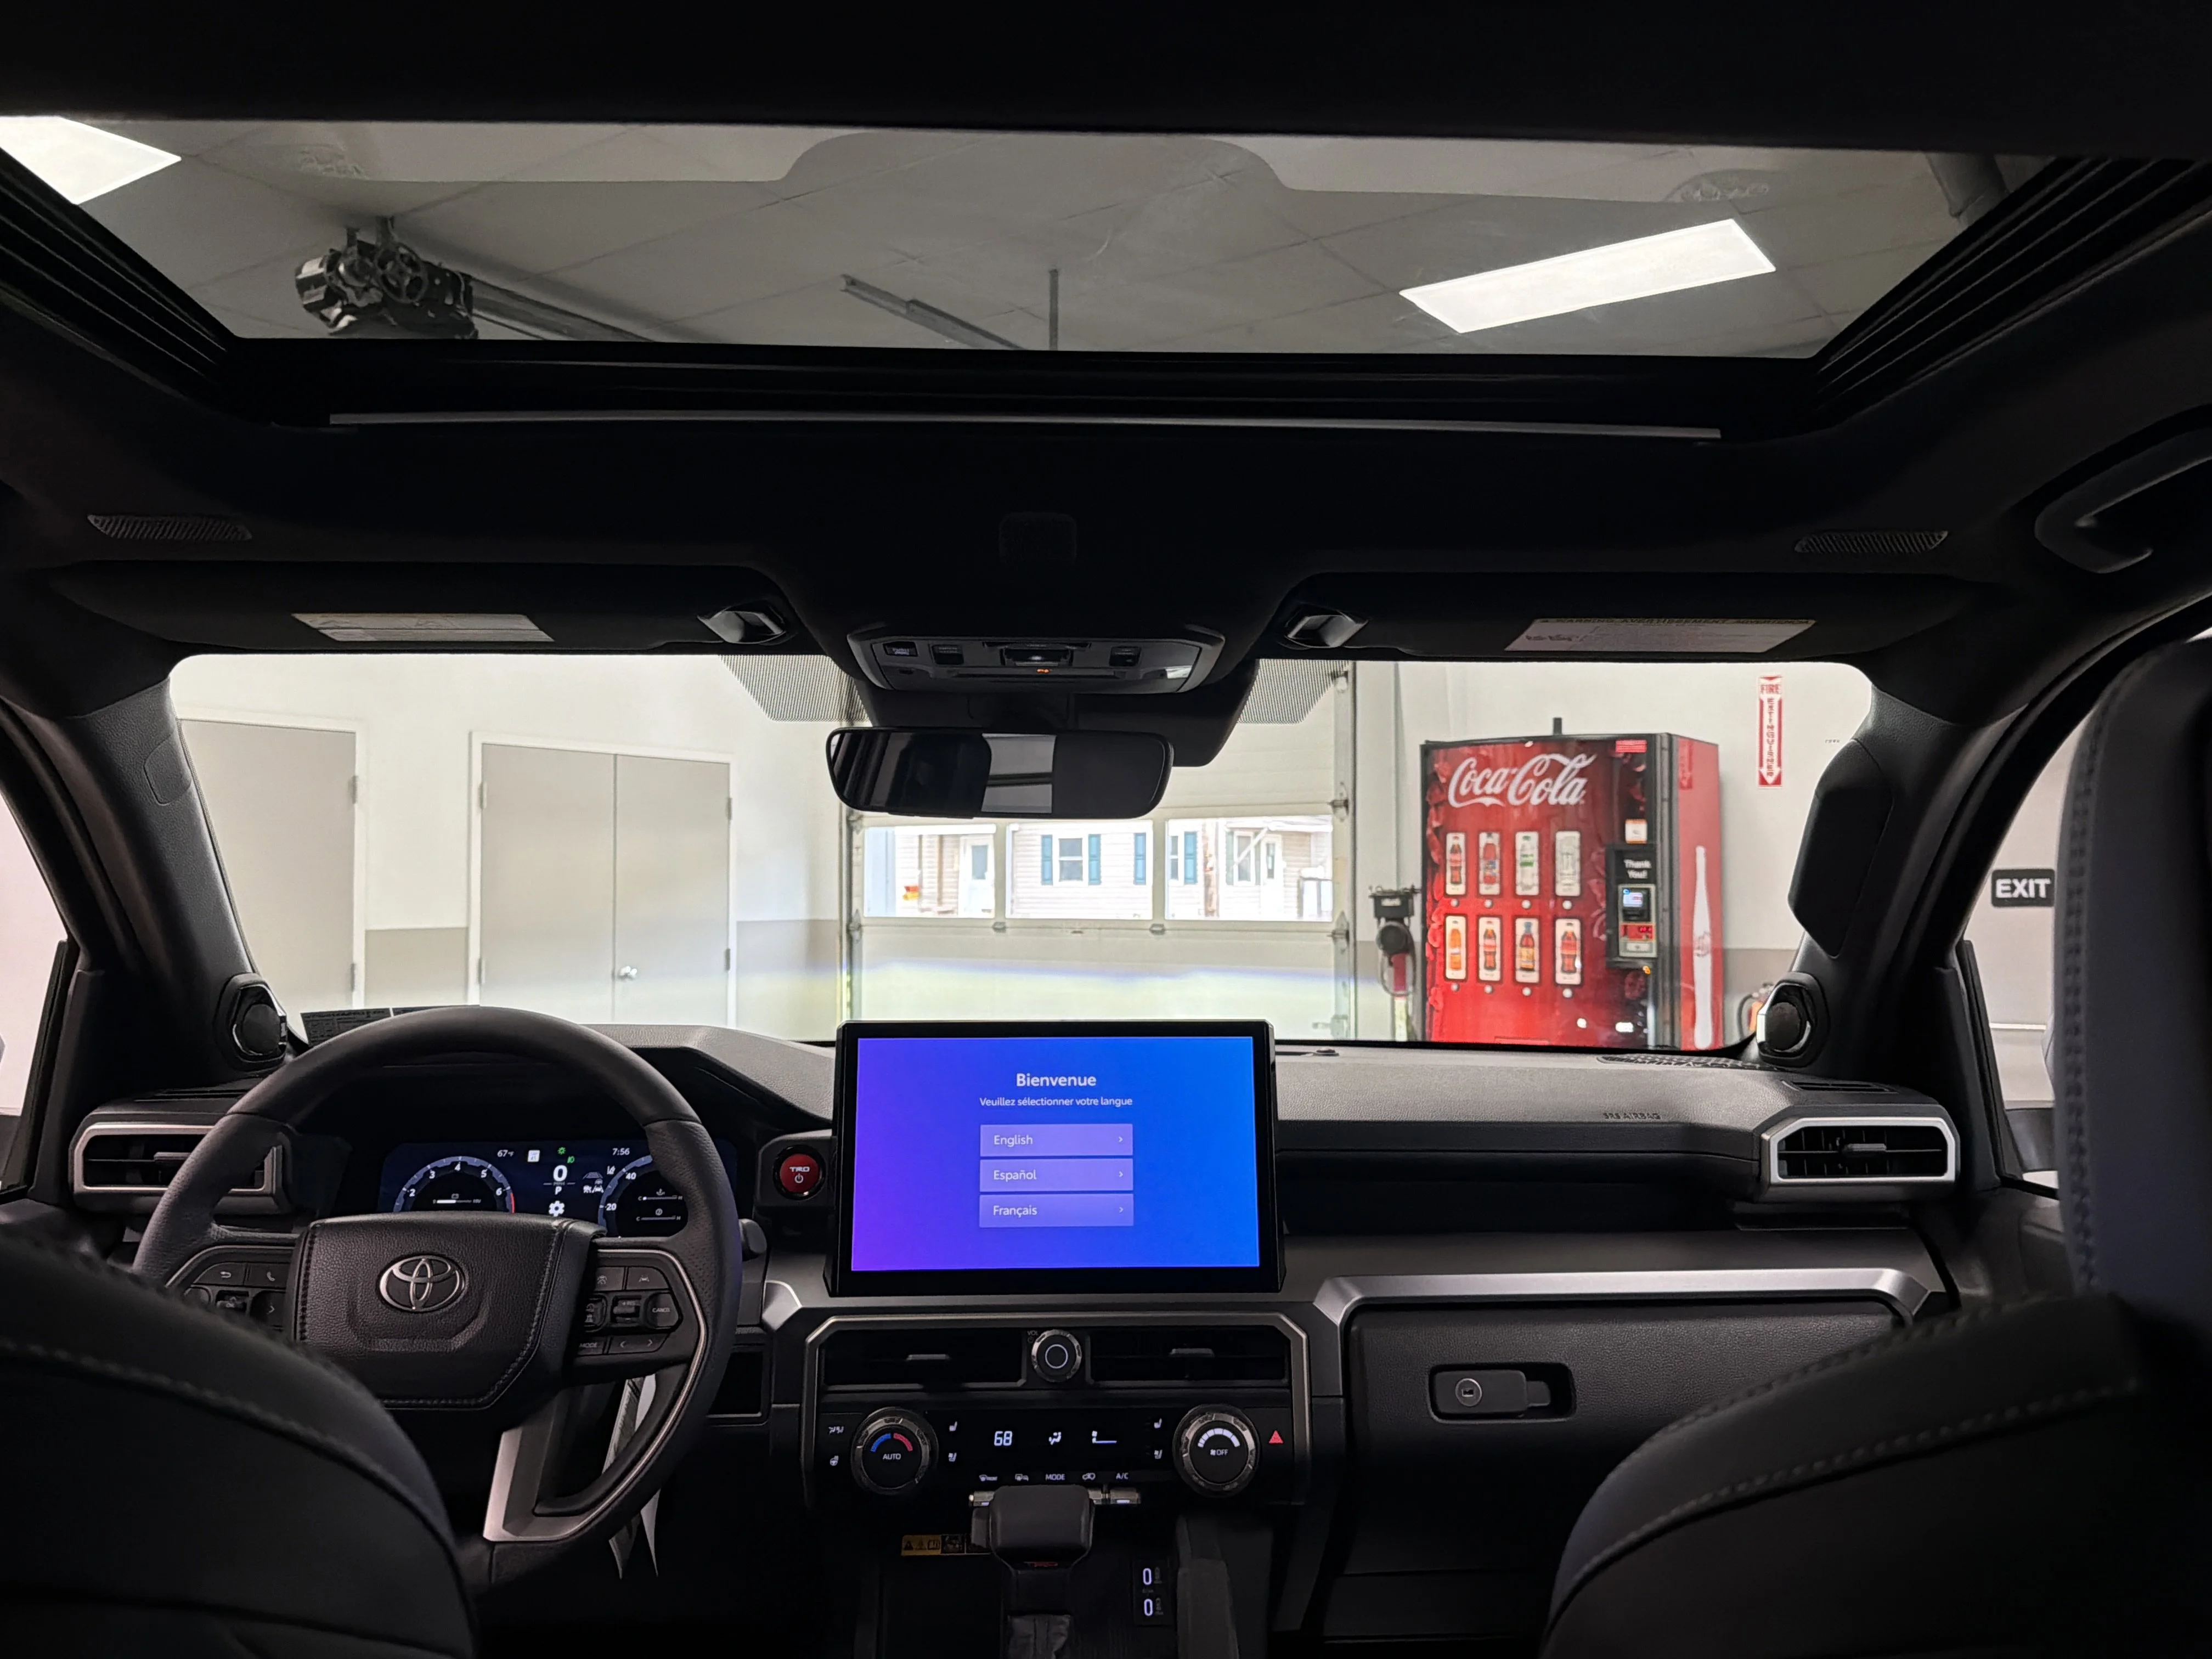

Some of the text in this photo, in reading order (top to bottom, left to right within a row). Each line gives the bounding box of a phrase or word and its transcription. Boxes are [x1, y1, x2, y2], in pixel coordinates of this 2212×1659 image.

[1760, 684, 1781, 695] FIRE
[1448, 753, 1598, 809] Coca-Cola
[1623, 859, 1652, 869] Thank
[1627, 870, 1647, 879] You!
[1996, 878, 2051, 898] EXIT
[1017, 1073, 1097, 1087] Bienvenue
[979, 1097, 1133, 1108] Veuillez sélectionner votre langue
[994, 1135, 1033, 1147] English
[612, 1148, 630, 1156] 7:56
[455, 1162, 461, 1171] 4
[429, 1170, 435, 1179] 3
[481, 1170, 487, 1178] 5
[553, 1165, 568, 1181] 0
[994, 1169, 1037, 1182] Español
[495, 1187, 503, 1196] 6
[555, 1186, 562, 1195] P
[994, 1205, 1037, 1218] Français
[994, 1430, 1013, 1446] 68
